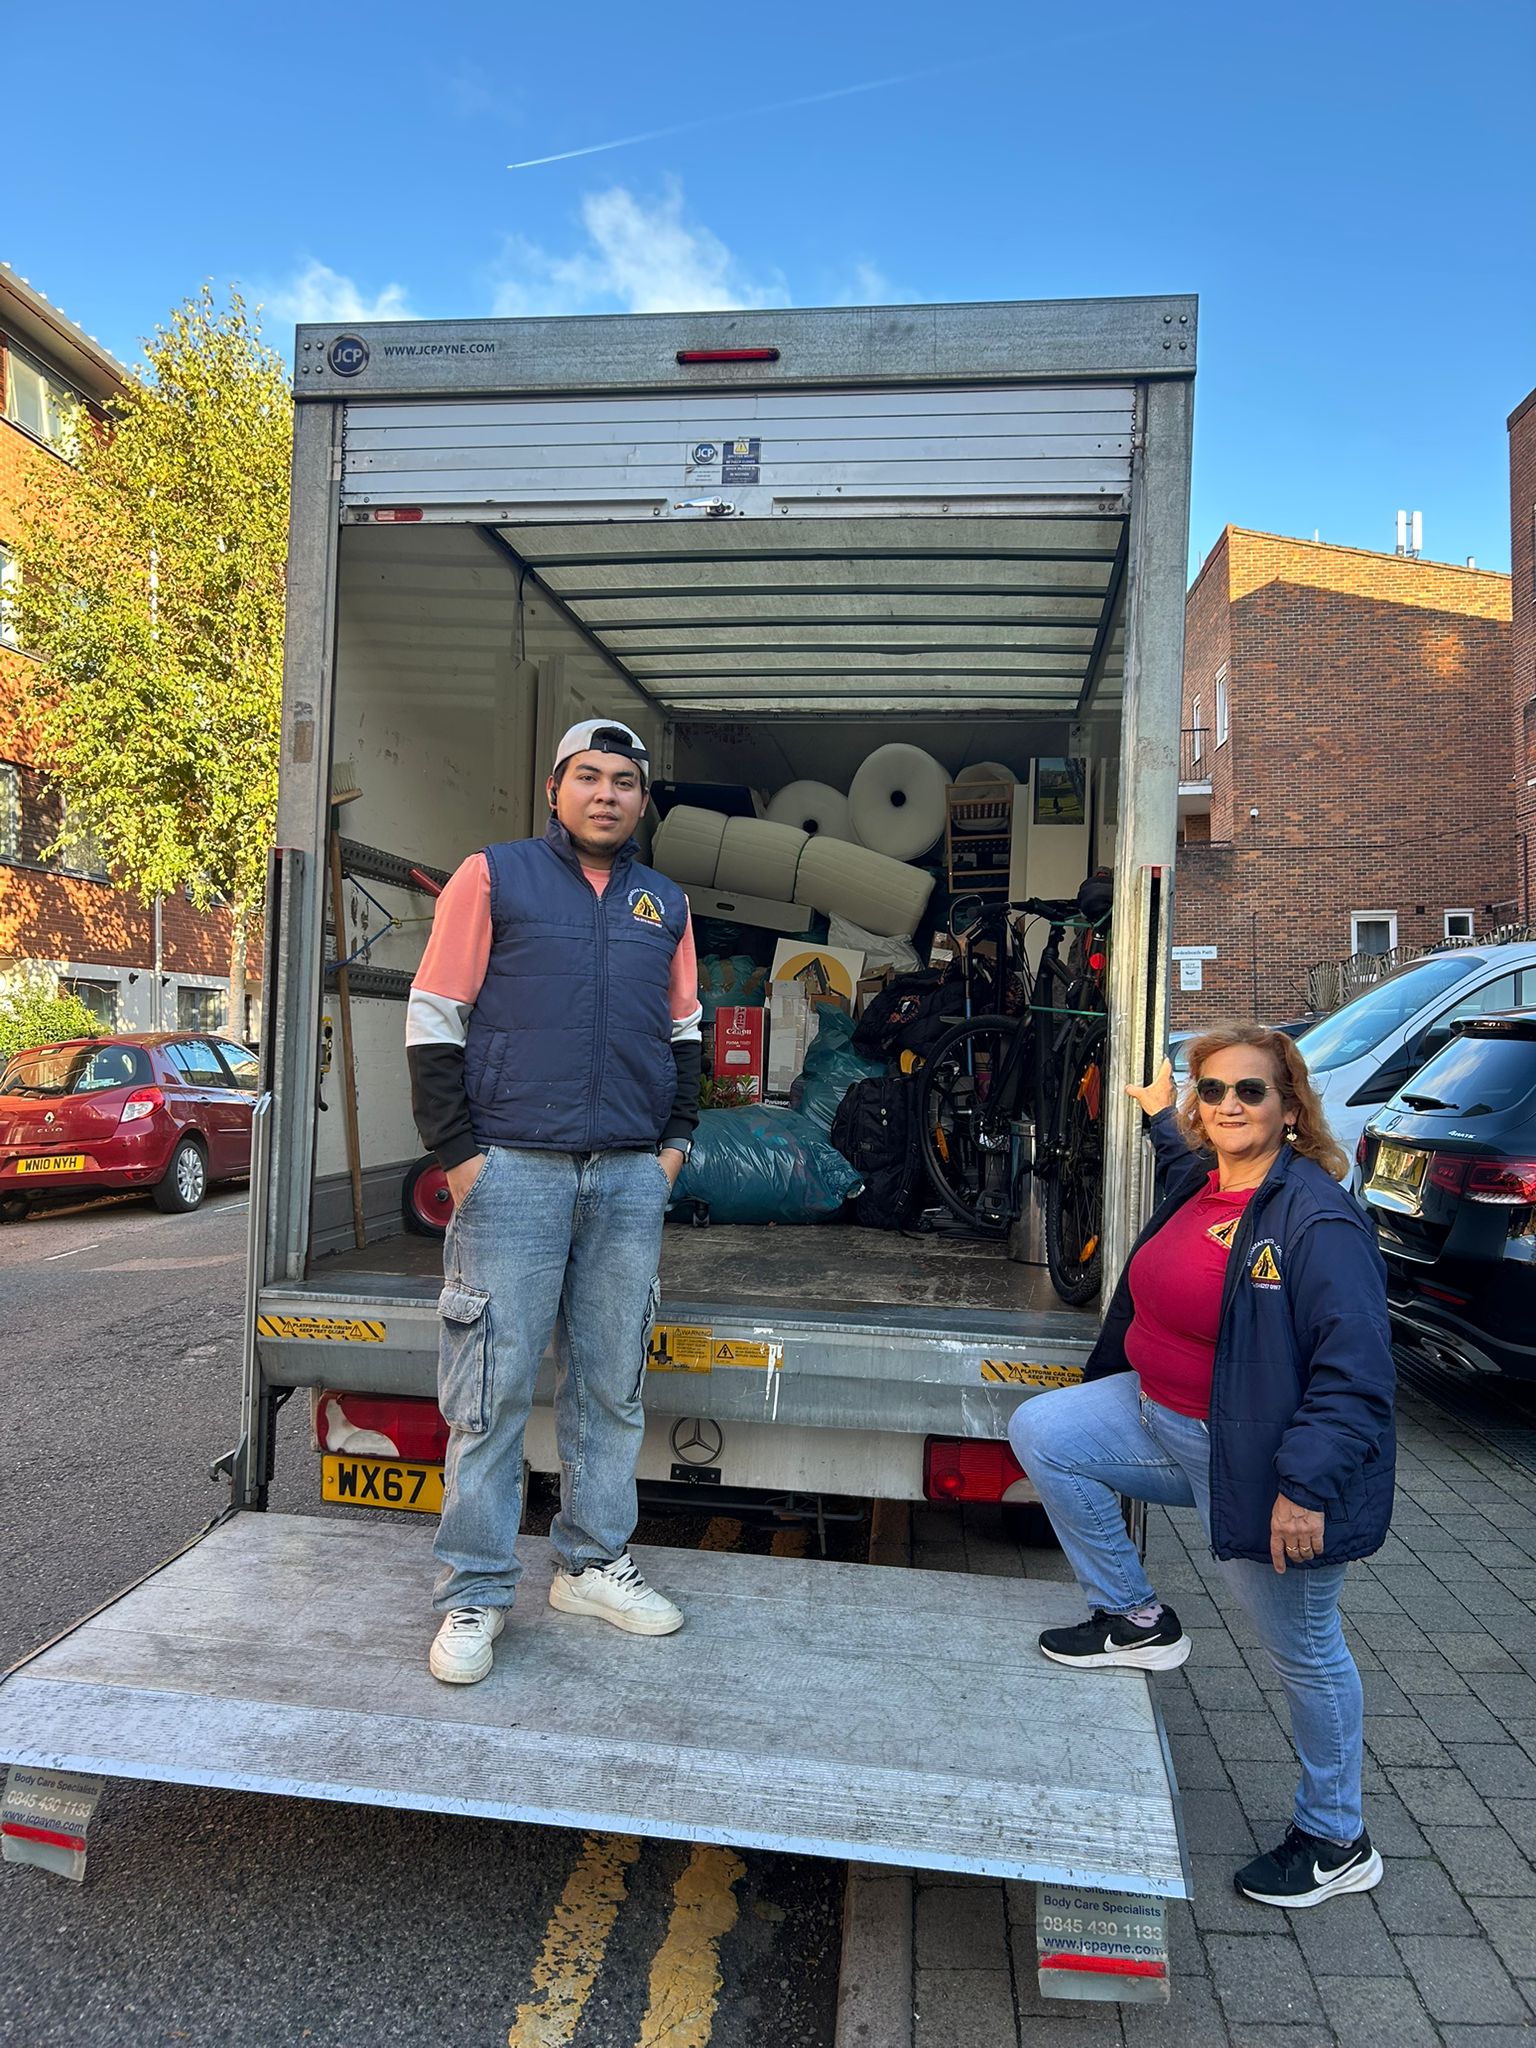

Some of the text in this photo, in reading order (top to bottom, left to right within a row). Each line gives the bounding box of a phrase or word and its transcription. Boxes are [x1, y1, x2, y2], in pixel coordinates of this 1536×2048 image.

[334, 343, 495, 363] JCP WWW.JCPAYNE.COM
[697, 448, 714, 458] JCP
[25, 1157, 77, 1171] WN10 NYH
[682, 1329, 712, 1337] WARNING
[1020, 1368, 1052, 1376] PLATFORM
[338, 1463, 427, 1504] WX67
[15, 1772, 36, 1786] Body
[37, 1776, 56, 1788] Care
[57, 1781, 98, 1796] Specialists
[7, 1790, 92, 1818] 0845 430 1133
[2, 1810, 84, 1833] www.jcpayne.com
[1043, 1895, 1161, 1917] Body Care Specialists
[1043, 1916, 1163, 1941] 0845 430 1133
[1043, 1937, 1164, 1956] www.jcpayne.com
